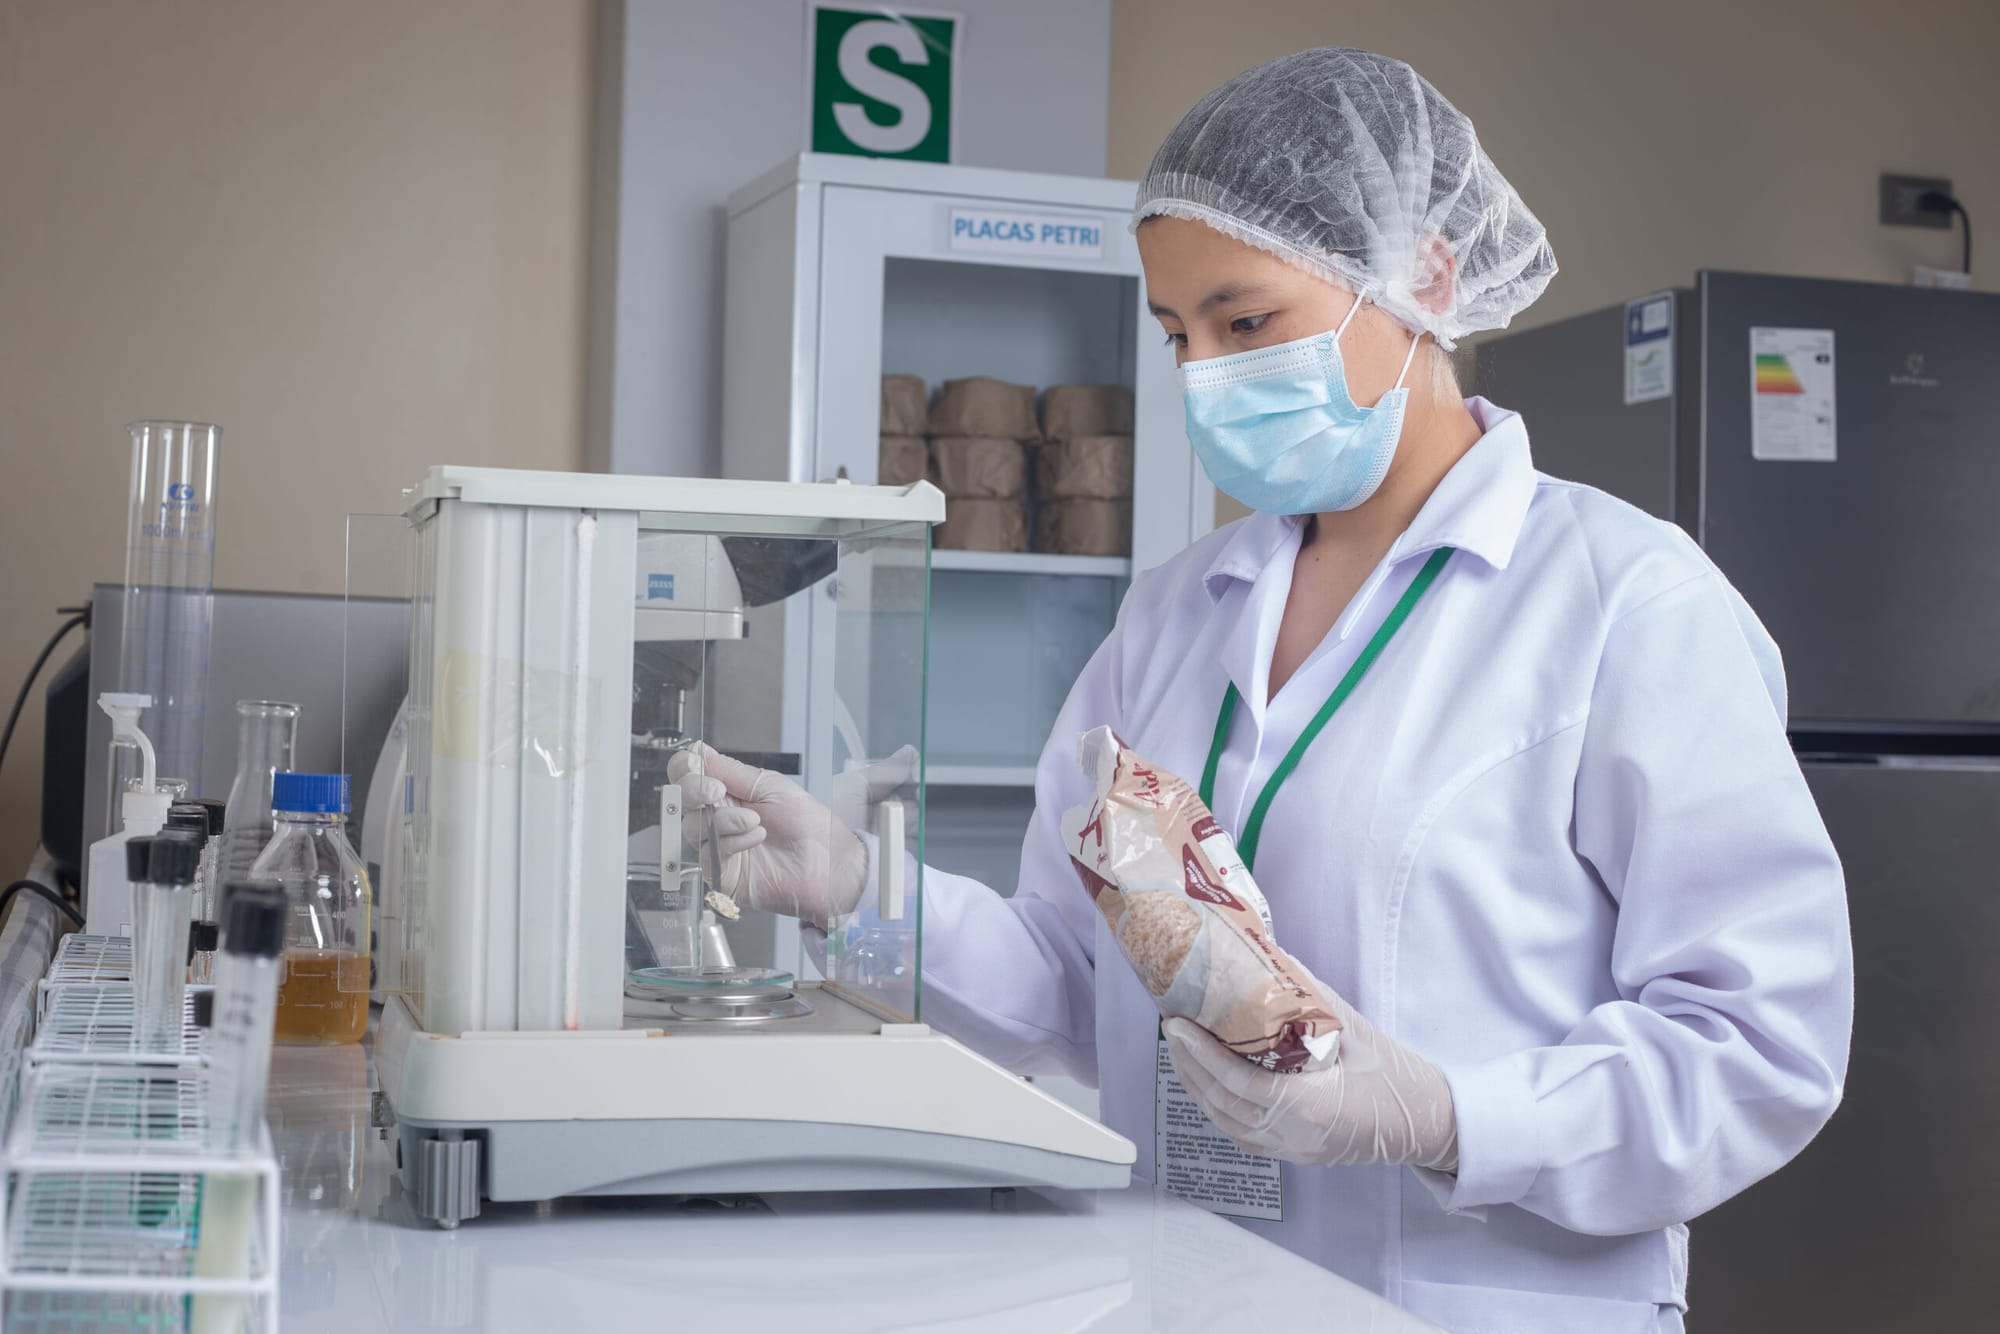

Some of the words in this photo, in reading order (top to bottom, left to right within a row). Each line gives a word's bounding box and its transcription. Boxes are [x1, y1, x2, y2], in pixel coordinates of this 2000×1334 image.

[831, 19, 932, 153] S
[954, 218, 1035, 243] PLACAS
[1041, 223, 1100, 247] PETRI
